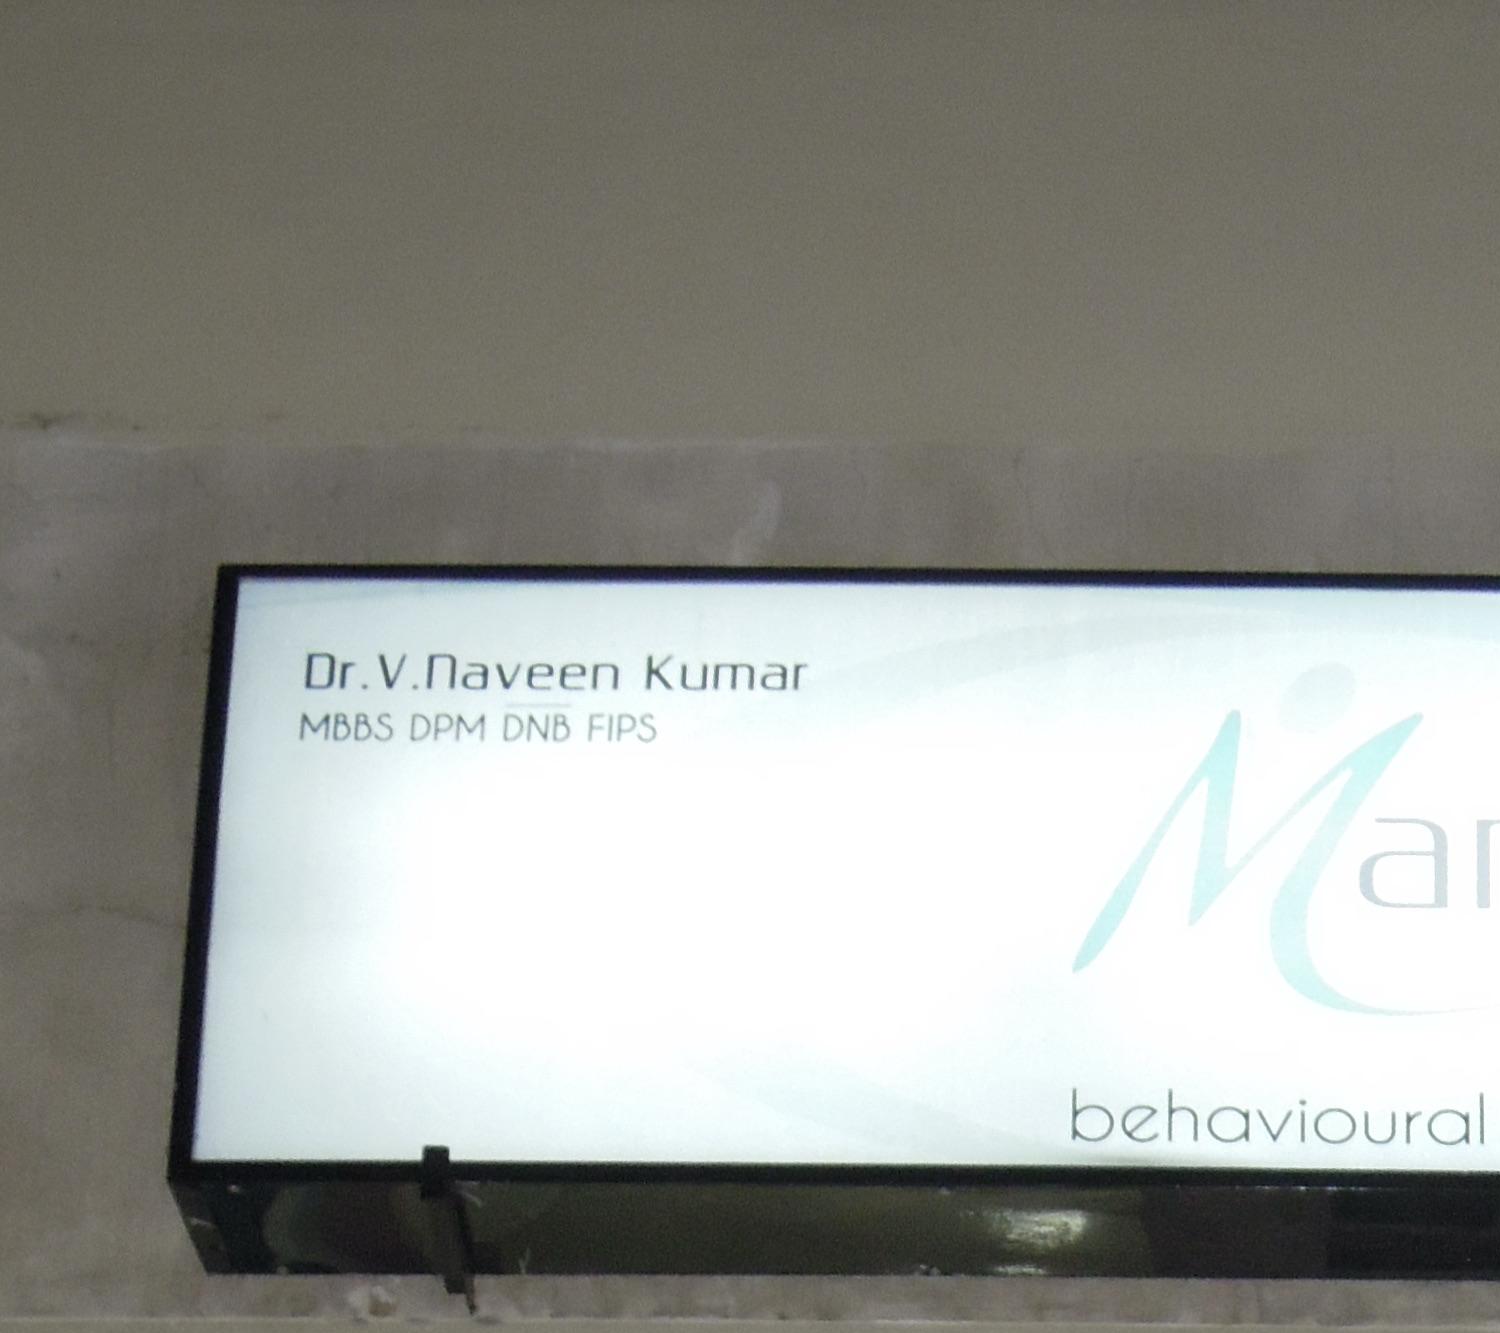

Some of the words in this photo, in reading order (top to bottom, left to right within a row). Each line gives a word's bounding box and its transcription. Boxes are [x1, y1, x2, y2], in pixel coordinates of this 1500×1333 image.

[645, 655, 808, 693] Kumar
[299, 714, 393, 742] MBBS
[410, 714, 485, 742] DPM
[503, 714, 571, 742] DNB
[588, 714, 658, 743] FIPS
[1070, 1087, 1485, 1147] behavioural
